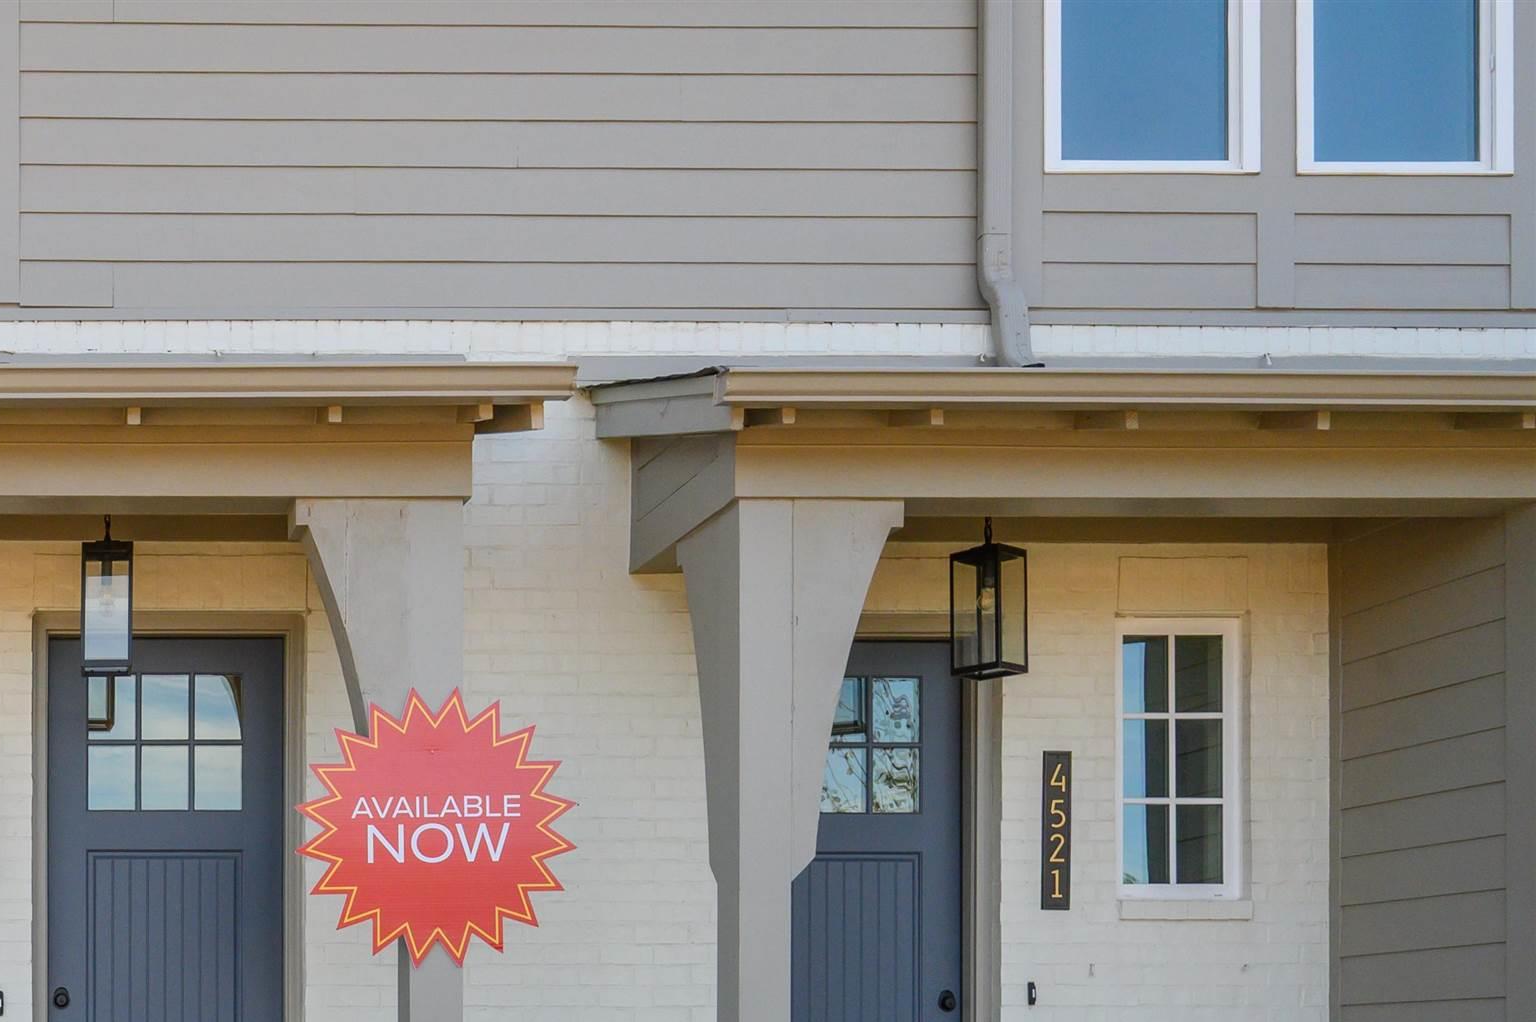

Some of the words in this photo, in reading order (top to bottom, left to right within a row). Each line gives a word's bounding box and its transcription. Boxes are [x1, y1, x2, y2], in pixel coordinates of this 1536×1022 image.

[351, 794, 521, 819] AVAILABLE
[366, 822, 510, 864] NOW
[1049, 763, 1066, 898] 4521
